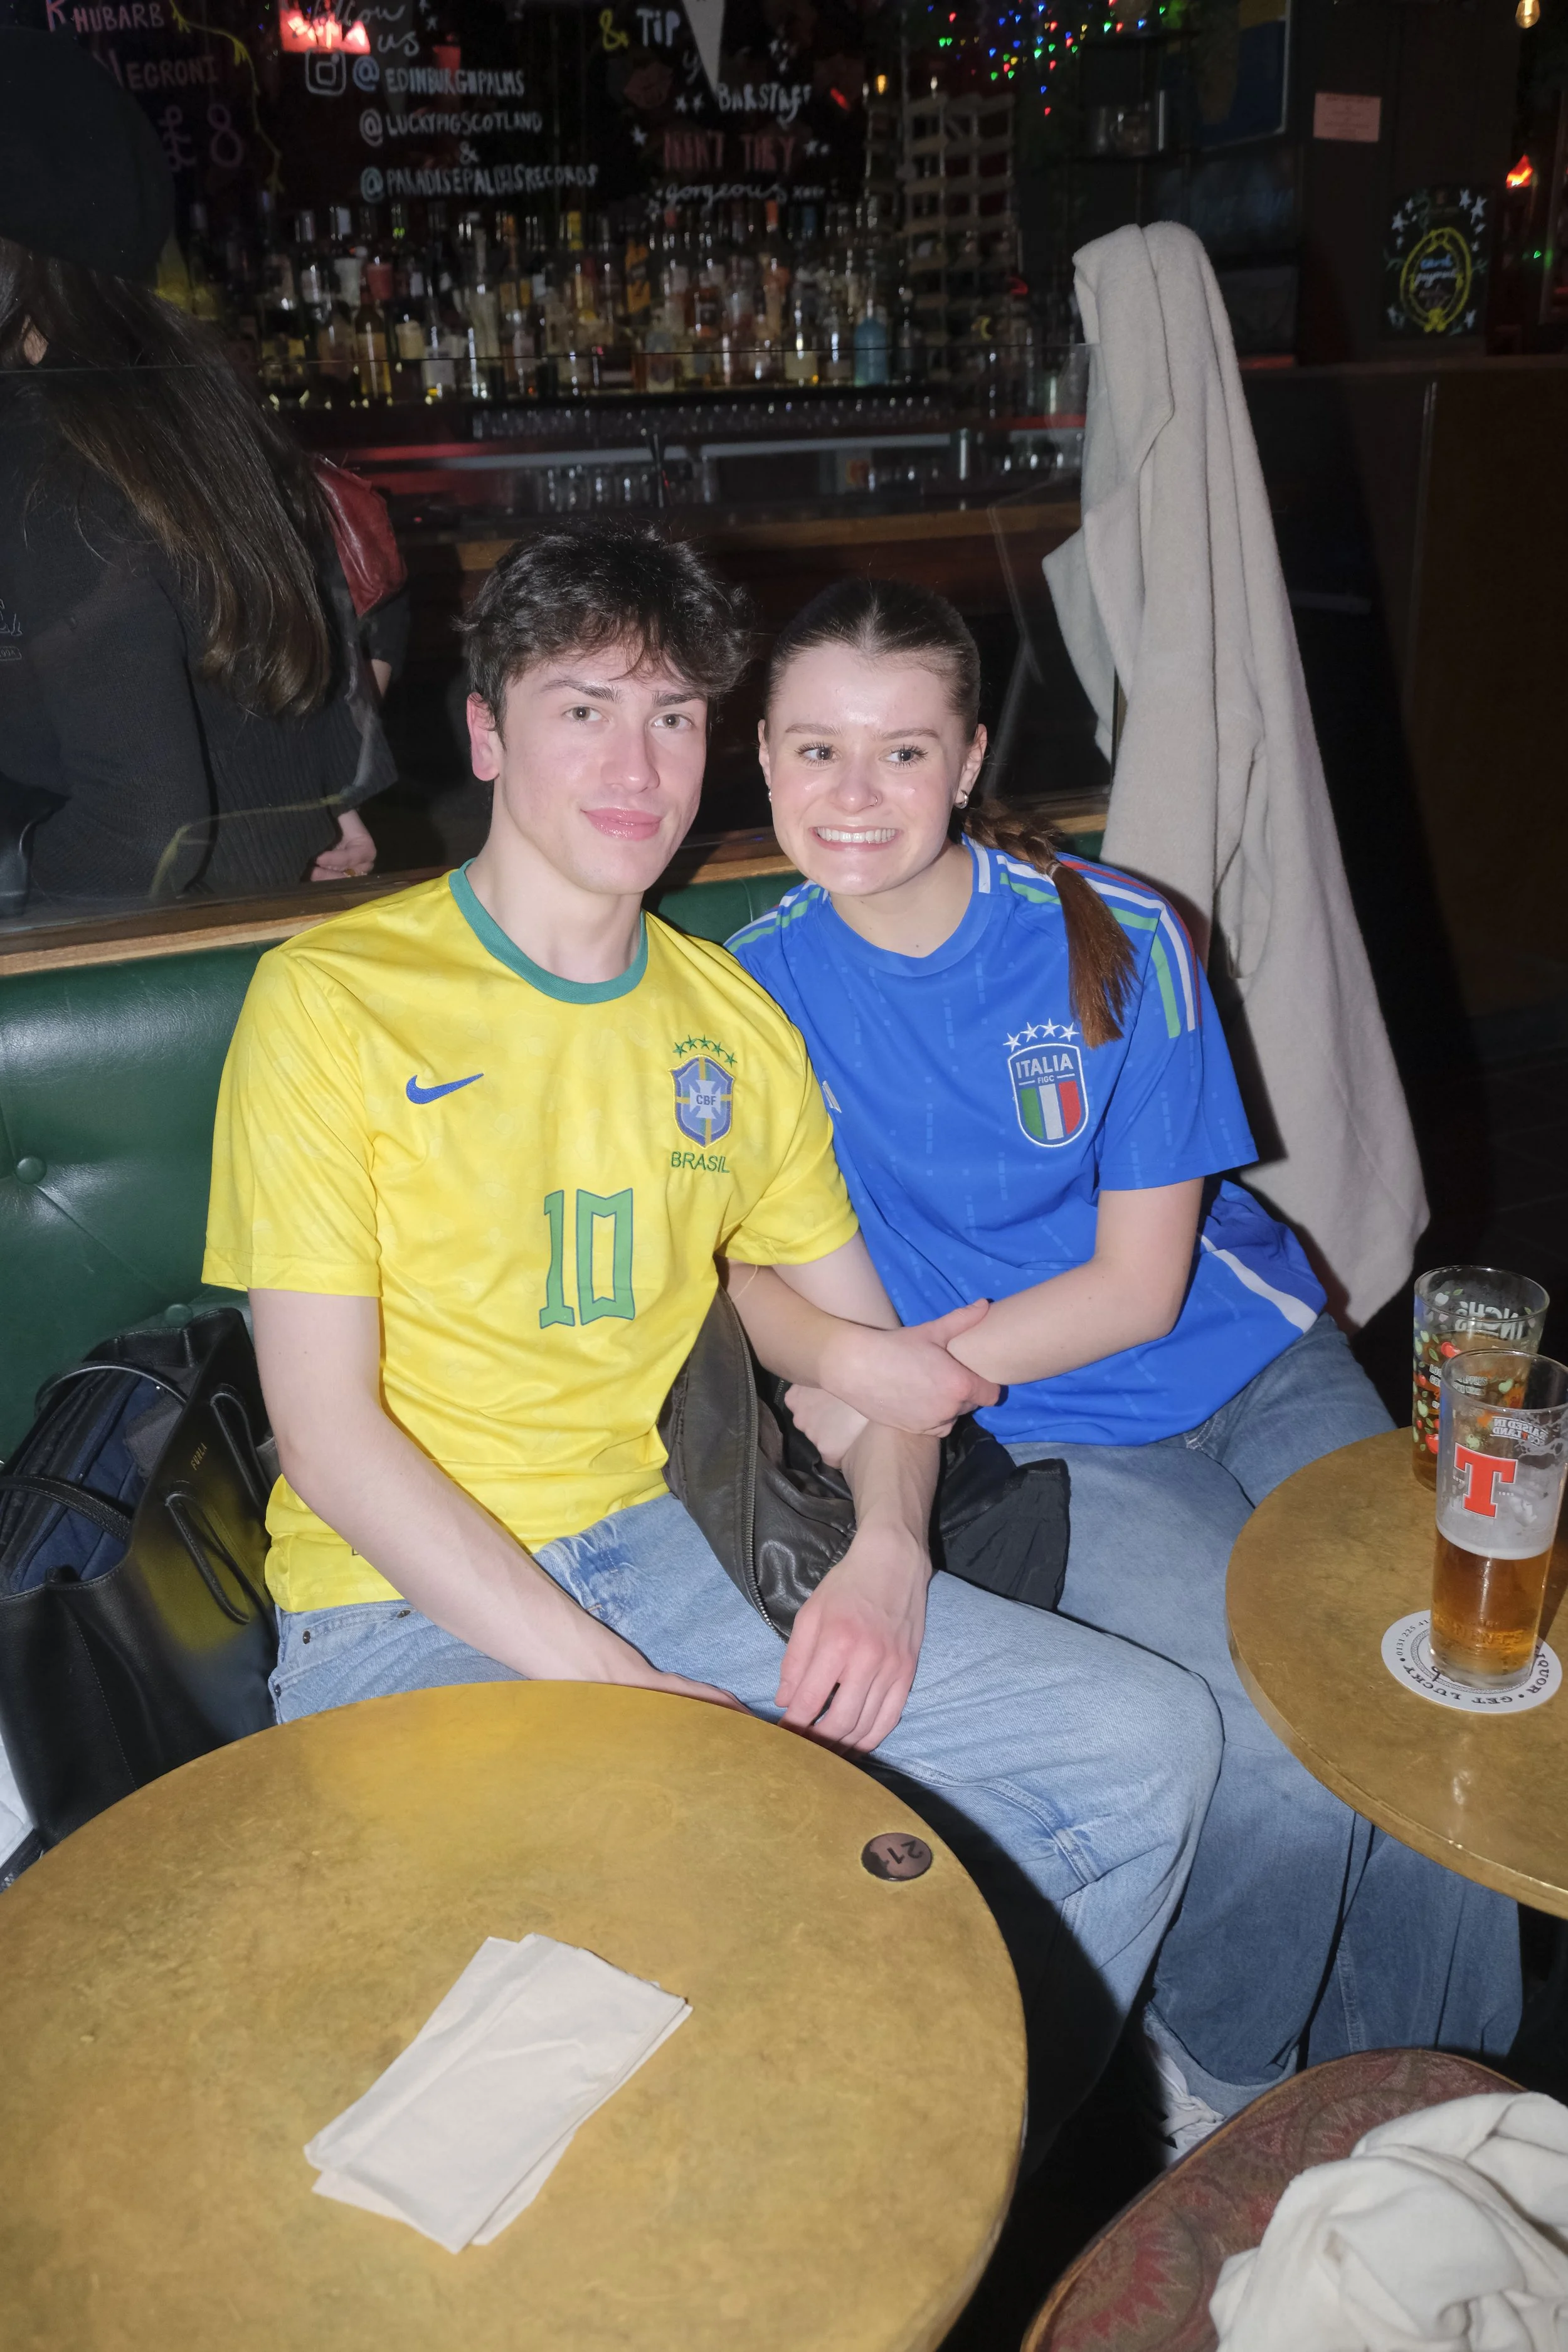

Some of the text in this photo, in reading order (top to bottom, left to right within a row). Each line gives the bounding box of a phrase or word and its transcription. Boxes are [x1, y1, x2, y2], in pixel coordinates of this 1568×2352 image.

[378, 31, 420, 56] us
[1015, 1053, 1073, 1078] ITALIA
[1037, 1074, 1054, 1084] FIGC
[696, 1094, 717, 1106] CBF
[671, 1152, 731, 1173] BRASIL
[539, 1188, 635, 1329] 10
[191, 1442, 207, 1471] FURLA
[1454, 1442, 1518, 1518] T
[1402, 1625, 1416, 1638] 225
[1419, 1618, 1431, 1626] 41
[1396, 1638, 1406, 1656] 0131
[1403, 1665, 1462, 1700] LUCKY
[1471, 1695, 1513, 1704] GET
